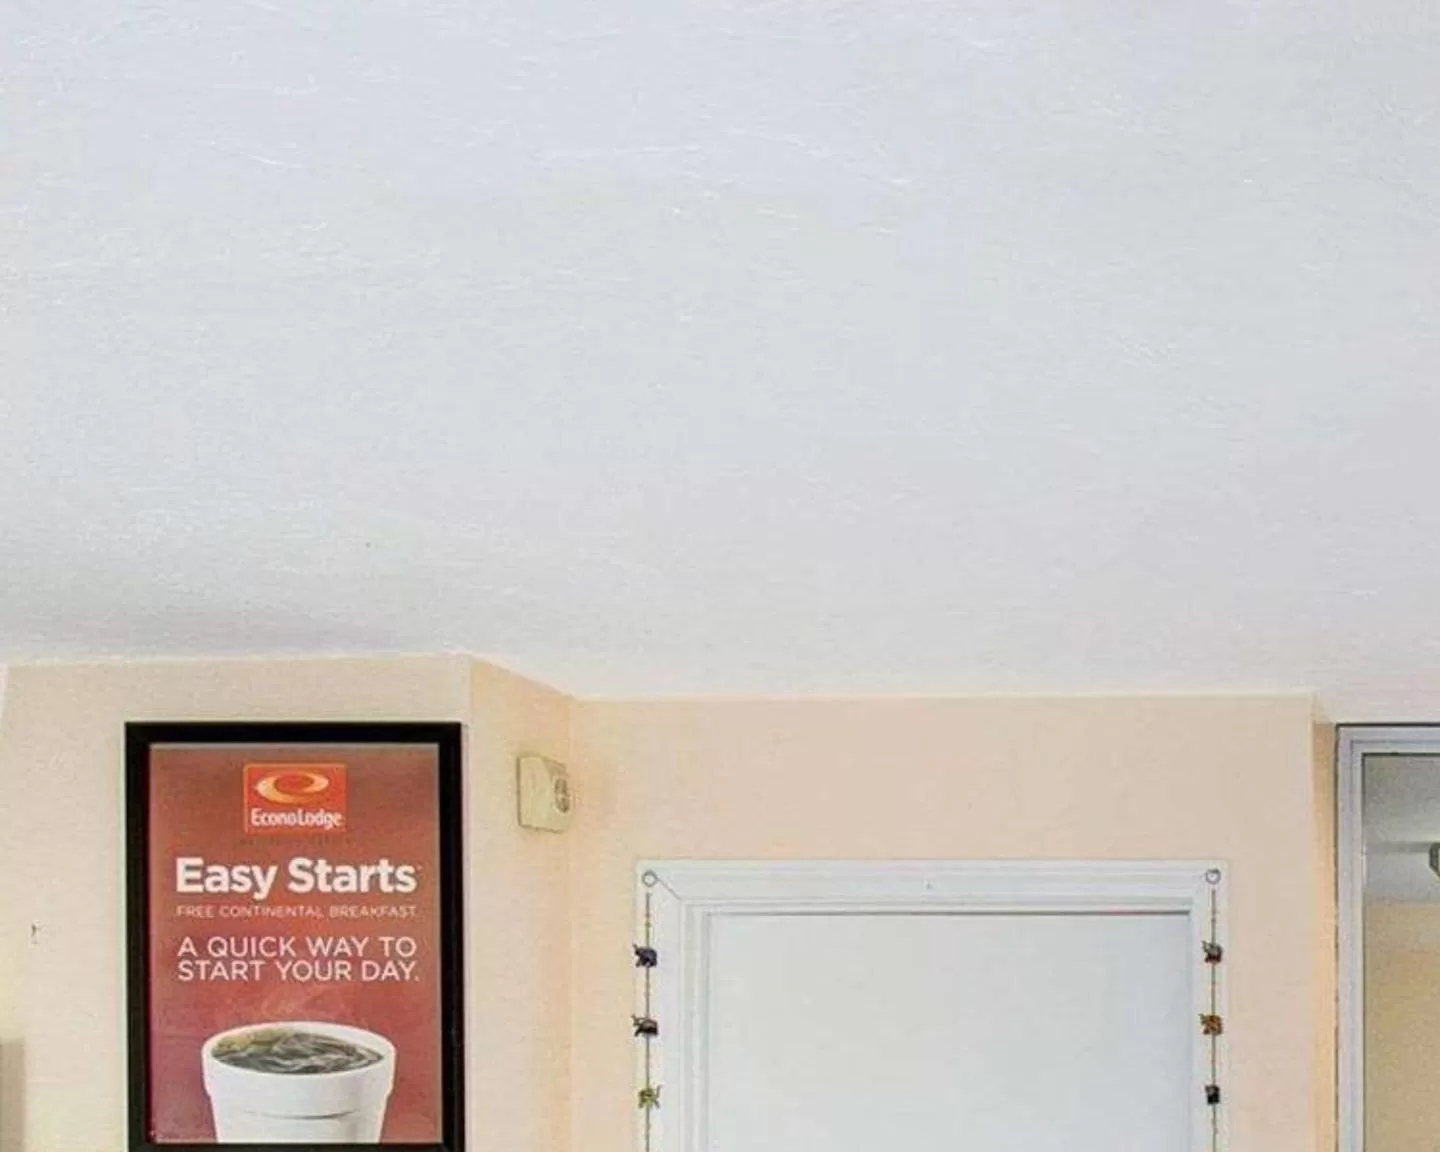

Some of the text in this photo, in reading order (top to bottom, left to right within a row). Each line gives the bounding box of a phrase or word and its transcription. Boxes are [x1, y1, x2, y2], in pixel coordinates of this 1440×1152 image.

[251, 808, 343, 830] EconoLodge
[176, 857, 418, 901] Easy Starts
[177, 905, 417, 919] FREE CONTINENTAL BREAKFAST
[177, 936, 417, 958] A QUICK WAY TO
[178, 959, 421, 982] START YOUR DAY.
